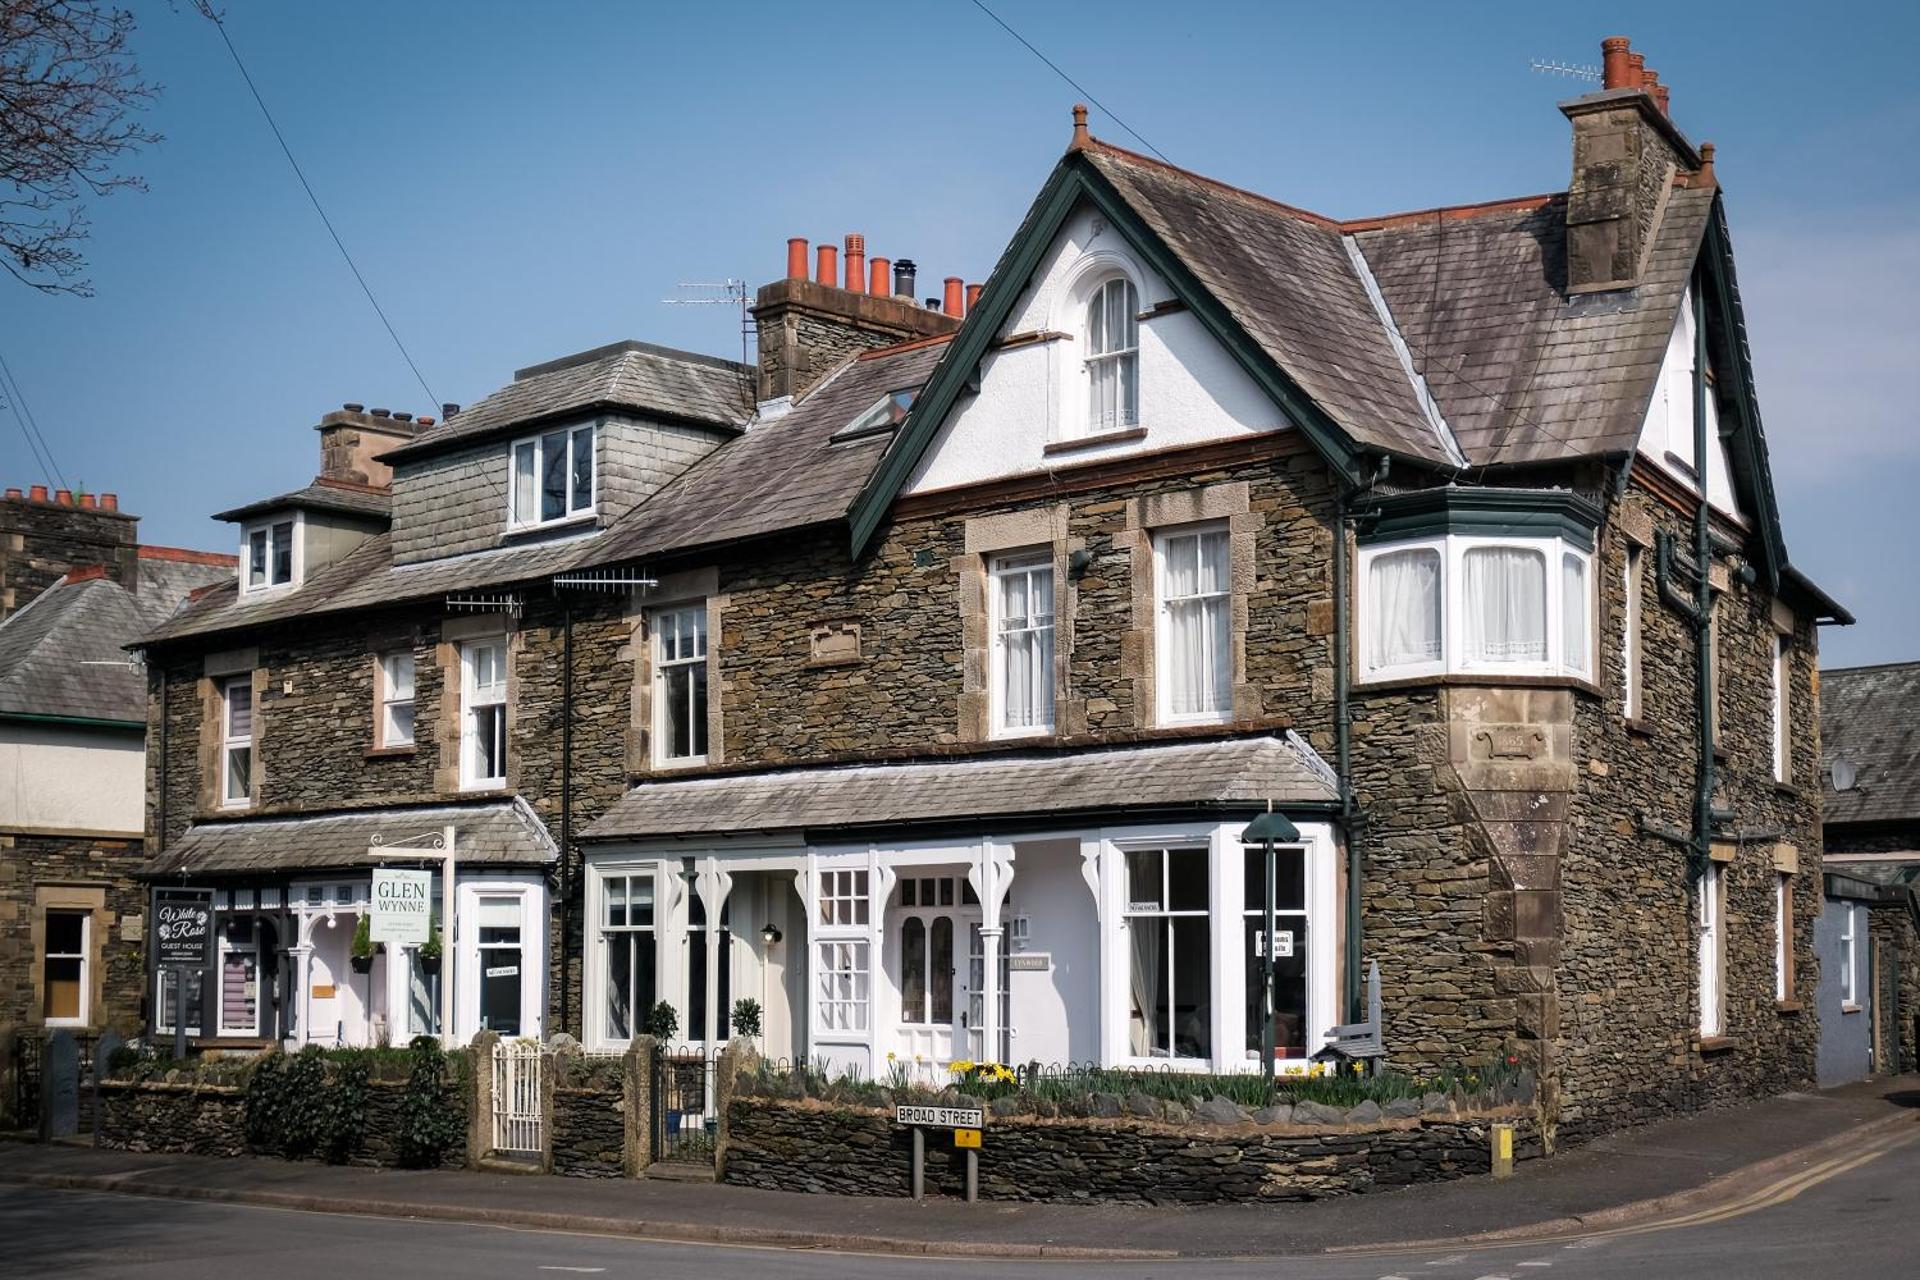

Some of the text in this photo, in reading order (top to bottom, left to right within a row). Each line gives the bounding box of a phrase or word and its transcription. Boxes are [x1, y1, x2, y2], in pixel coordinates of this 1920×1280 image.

[378, 881, 425, 899] GLEN
[159, 906, 197, 923] White
[378, 900, 425, 912] WYNNE
[172, 921, 206, 939] Rose
[899, 1108, 980, 1125] BROAD STREET
